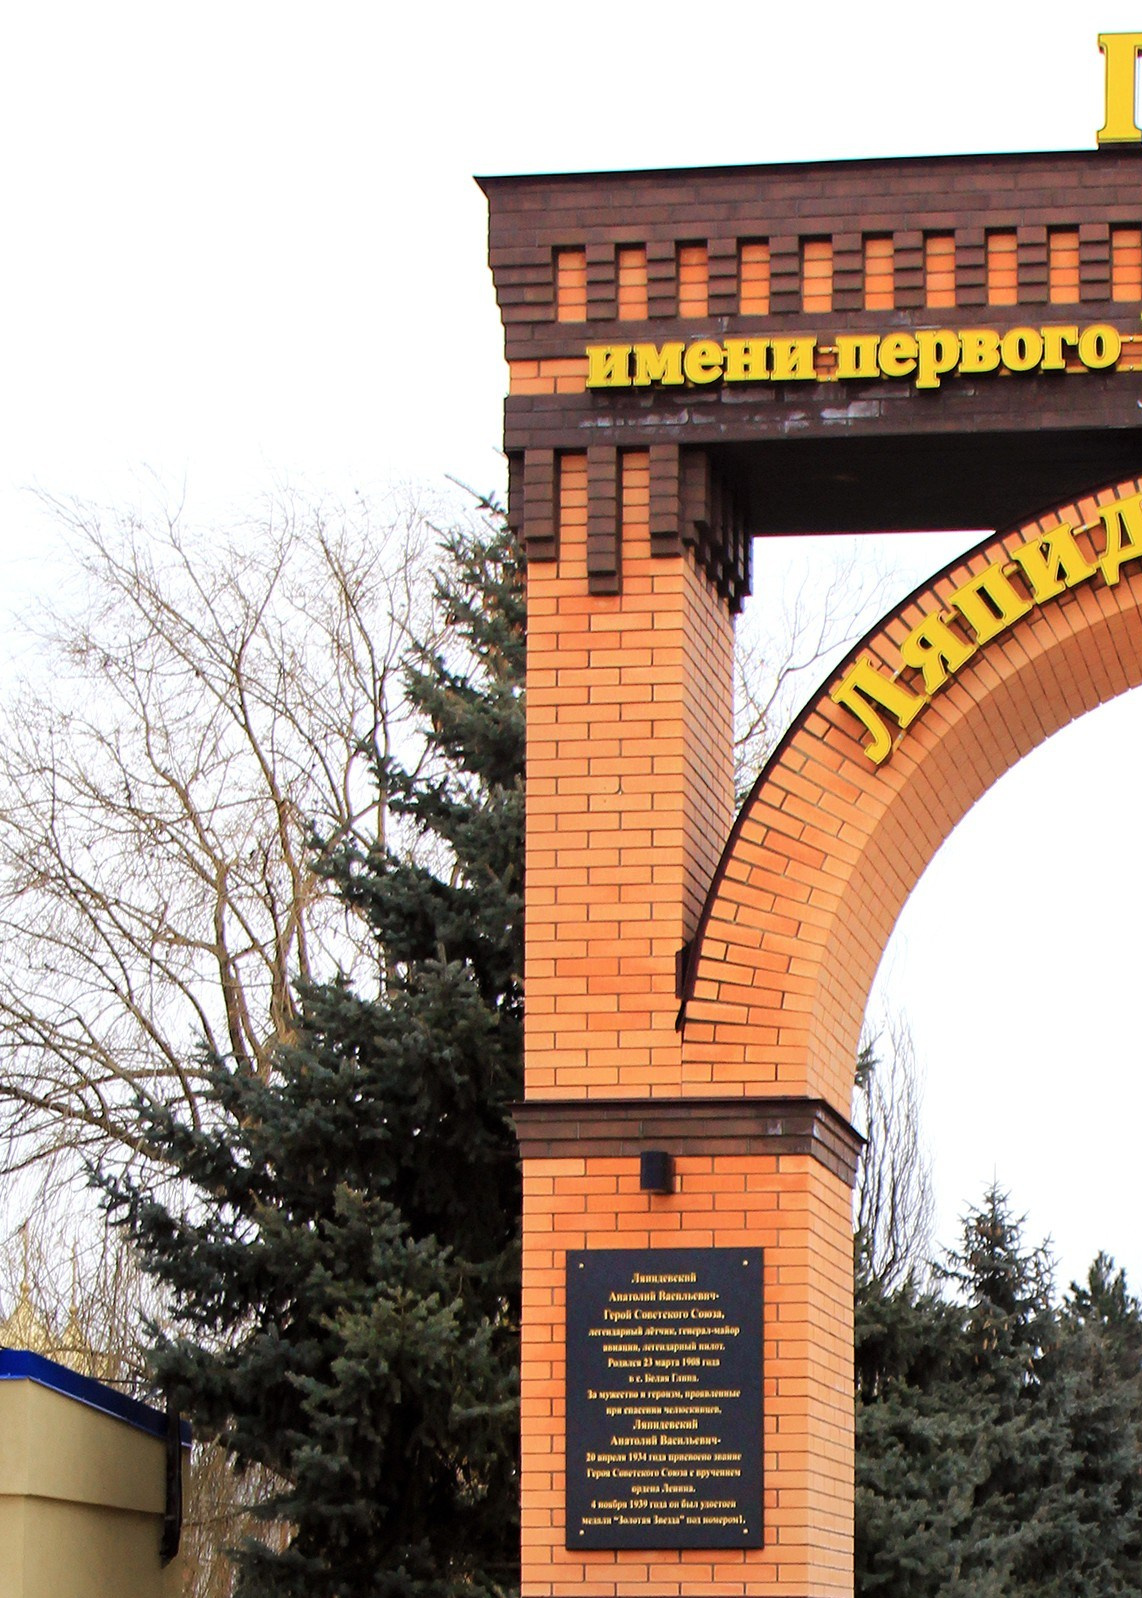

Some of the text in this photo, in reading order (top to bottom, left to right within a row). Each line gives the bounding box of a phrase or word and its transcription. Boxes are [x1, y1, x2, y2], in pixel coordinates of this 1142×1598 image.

[584, 336, 817, 390] имени
[836, 322, 1124, 390] первого
[609, 1292, 656, 1302] Анатолий
[604, 1309, 632, 1322] Герой
[634, 1309, 689, 1319] Советского
[588, 1326, 643, 1337] легендарный
[608, 1358, 641, 1368] Родился
[643, 1358, 653, 1367] 23
[655, 1359, 679, 1368] марта
[702, 1359, 720, 1367] года
[645, 1374, 669, 1382] Белая
[587, 1390, 598, 1399] За
[611, 1436, 657, 1446] Анатолий
[586, 1453, 596, 1462] 20
[629, 1453, 647, 1462] 1934
[648, 1454, 666, 1462] года
[587, 1470, 610, 1479] Героя
[612, 1469, 659, 1478] Советского
[661, 1469, 688, 1477] Союза
[598, 1500, 627, 1510] ноября
[630, 1500, 648, 1509] 1939
[650, 1501, 667, 1509] года
